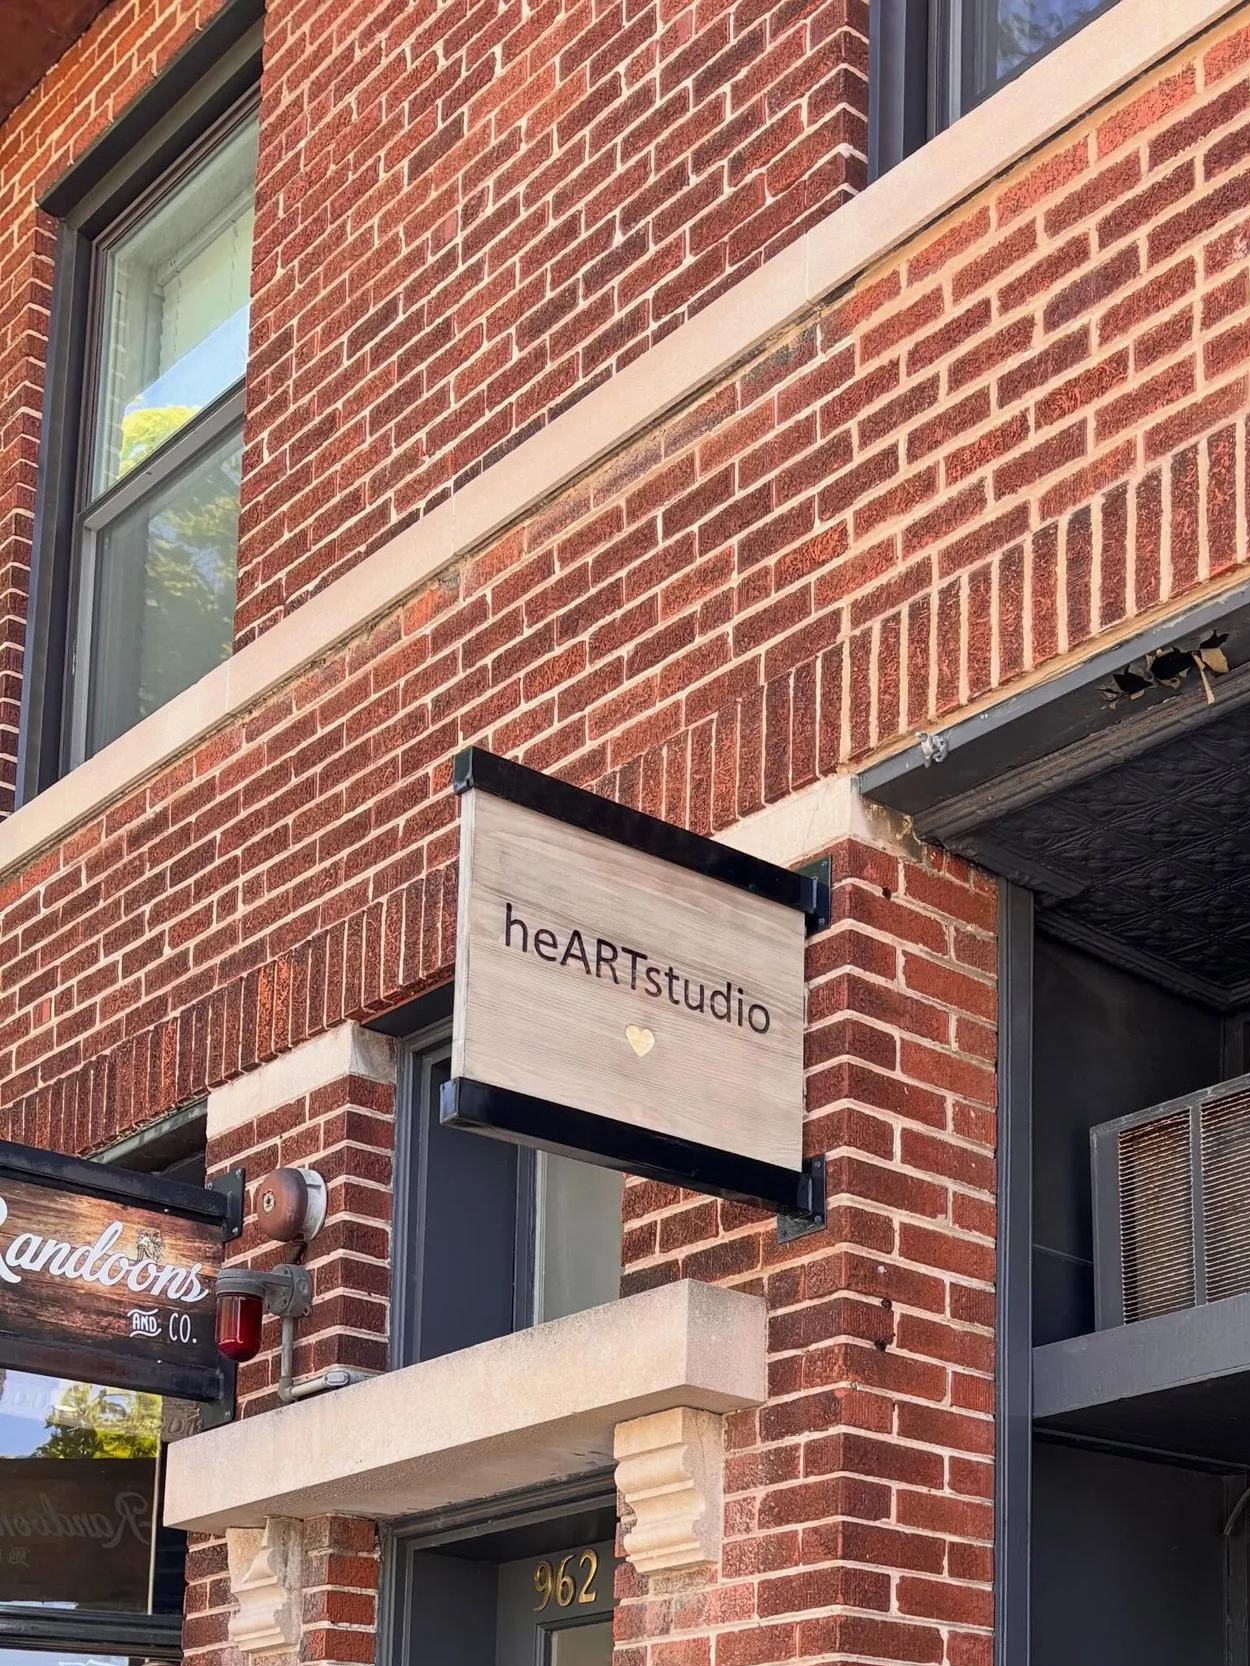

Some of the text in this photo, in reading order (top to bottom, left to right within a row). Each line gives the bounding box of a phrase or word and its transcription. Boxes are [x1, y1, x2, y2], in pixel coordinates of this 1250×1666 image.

[505, 902, 771, 1034] heARTstudio
[129, 1311, 197, 1344] AND CO.
[533, 1549, 598, 1612] 962
